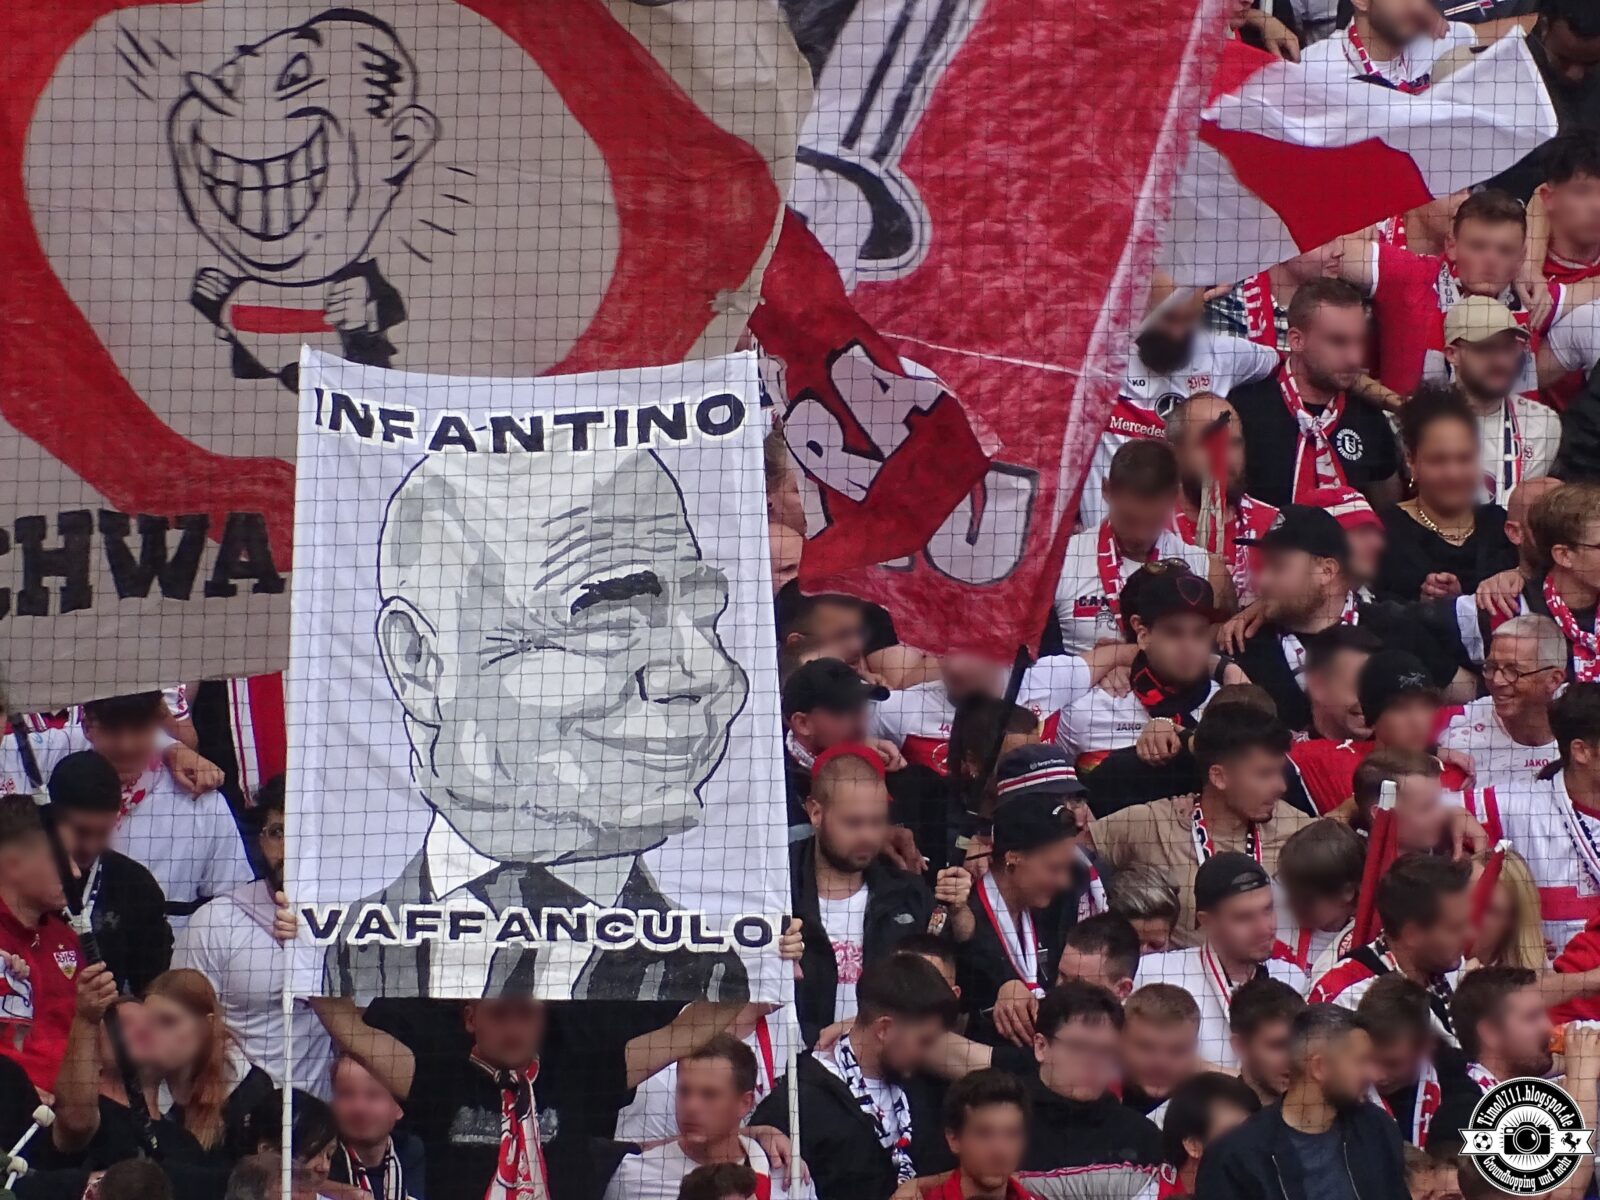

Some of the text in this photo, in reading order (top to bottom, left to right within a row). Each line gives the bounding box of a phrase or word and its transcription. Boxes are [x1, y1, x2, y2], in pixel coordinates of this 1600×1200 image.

[315, 387, 746, 453] INFANTINO
[1109, 415, 1166, 438] Mercedes
[1524, 759, 1549, 768] JAKO
